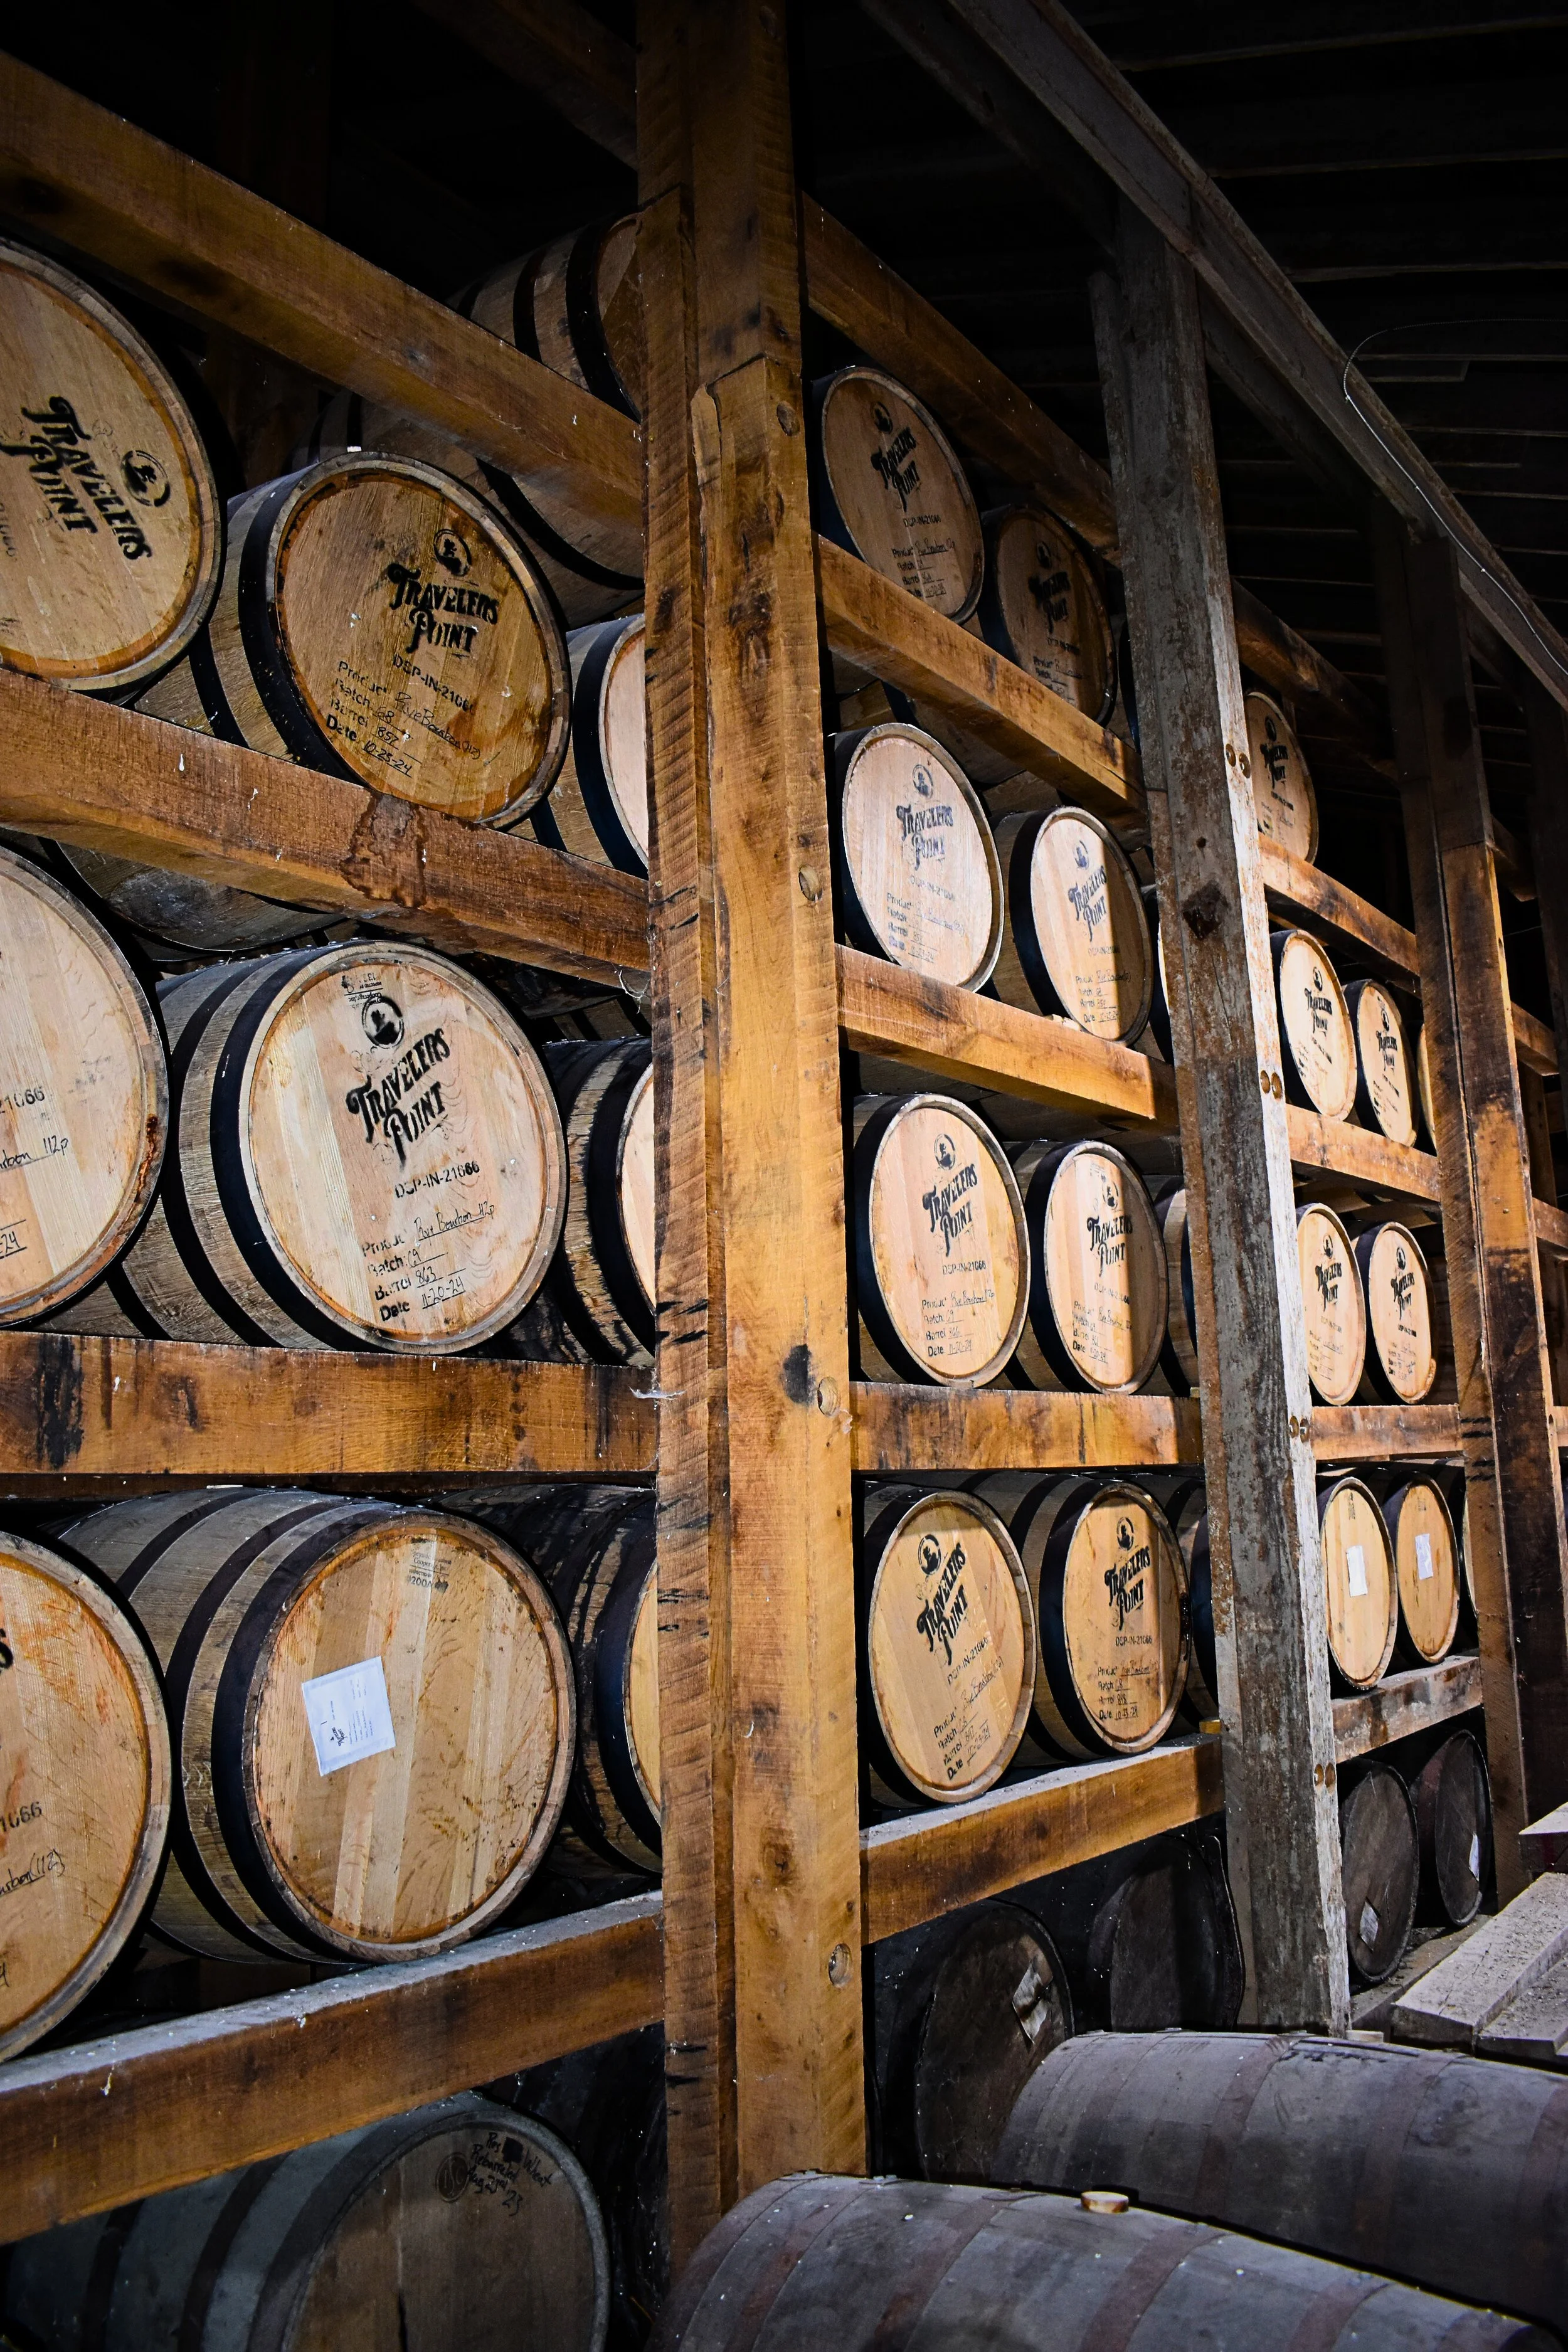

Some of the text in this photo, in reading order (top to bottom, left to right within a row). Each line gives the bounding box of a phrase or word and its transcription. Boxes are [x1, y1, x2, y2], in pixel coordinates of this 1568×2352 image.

[0, 435, 97, 533] POINT
[21, 396, 152, 559] TRAVELERS
[871, 427, 917, 490] TRAVELERS
[892, 460, 920, 512] POINT
[387, 564, 499, 624] TRAVELERS
[406, 608, 479, 654] POINT
[896, 803, 953, 841] TRAVELERS
[912, 832, 945, 871] POINT
[1068, 865, 1107, 921] TRAVELERS
[1083, 896, 1107, 942] POINT
[346, 1028, 450, 1143] TRAVELERS
[384, 1081, 448, 1168] POINT
[922, 1163, 978, 1232] TRAVELERS
[940, 1200, 973, 1258] POINT
[1087, 1214, 1133, 1251] TRAVELERS
[1097, 1241, 1125, 1277] POINT
[917, 1542, 965, 1652] TRAVELERS
[1104, 1545, 1151, 1606] TRAVELERS
[1116, 1578, 1144, 1631] POINT
[938, 1584, 968, 1666] POINT
